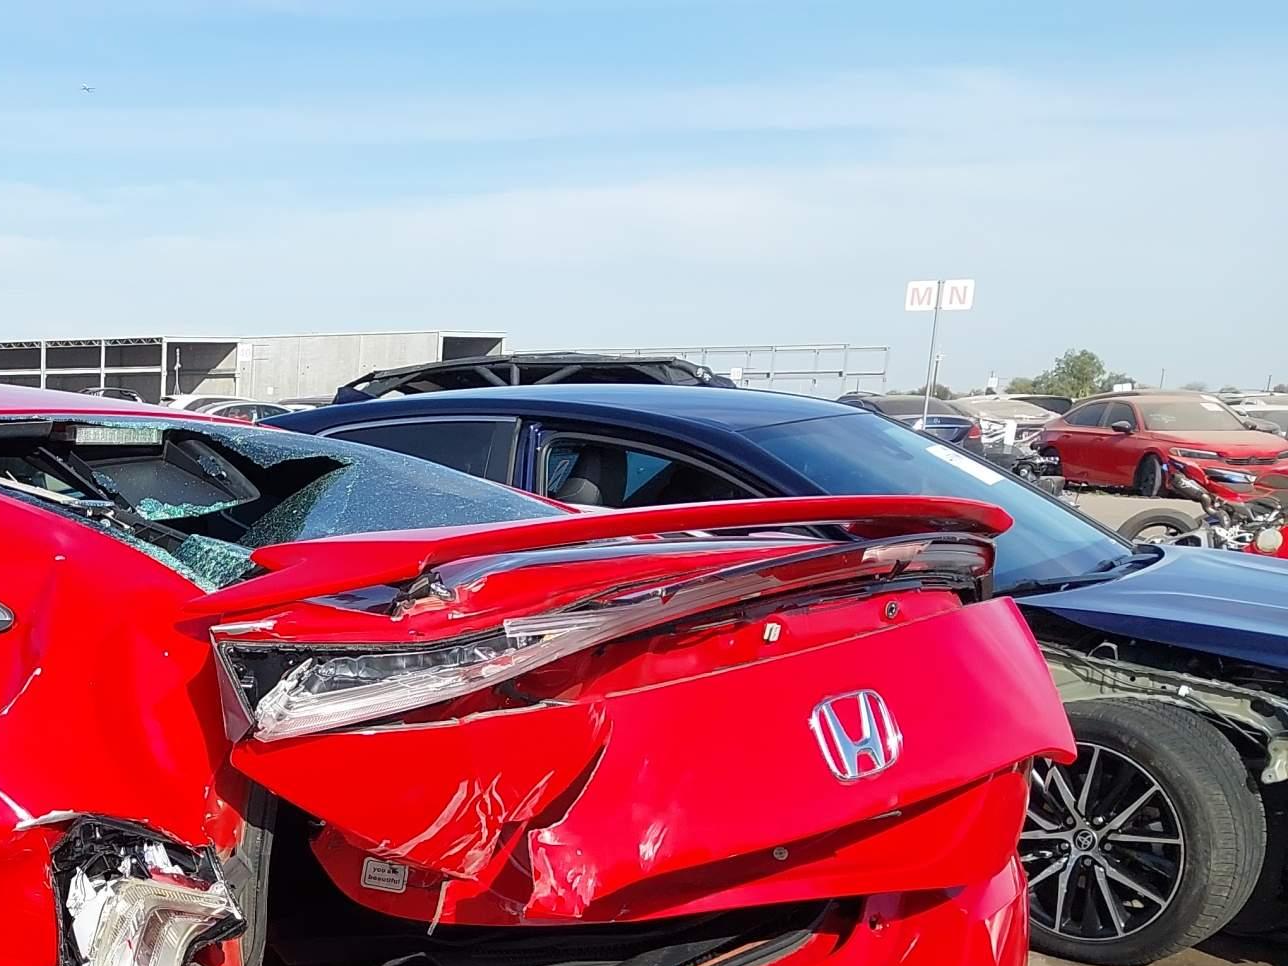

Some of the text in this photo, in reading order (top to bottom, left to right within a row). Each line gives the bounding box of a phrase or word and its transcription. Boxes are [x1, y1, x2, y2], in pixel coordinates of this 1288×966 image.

[909, 285, 968, 306] M N
[368, 874, 401, 885] beautiful
